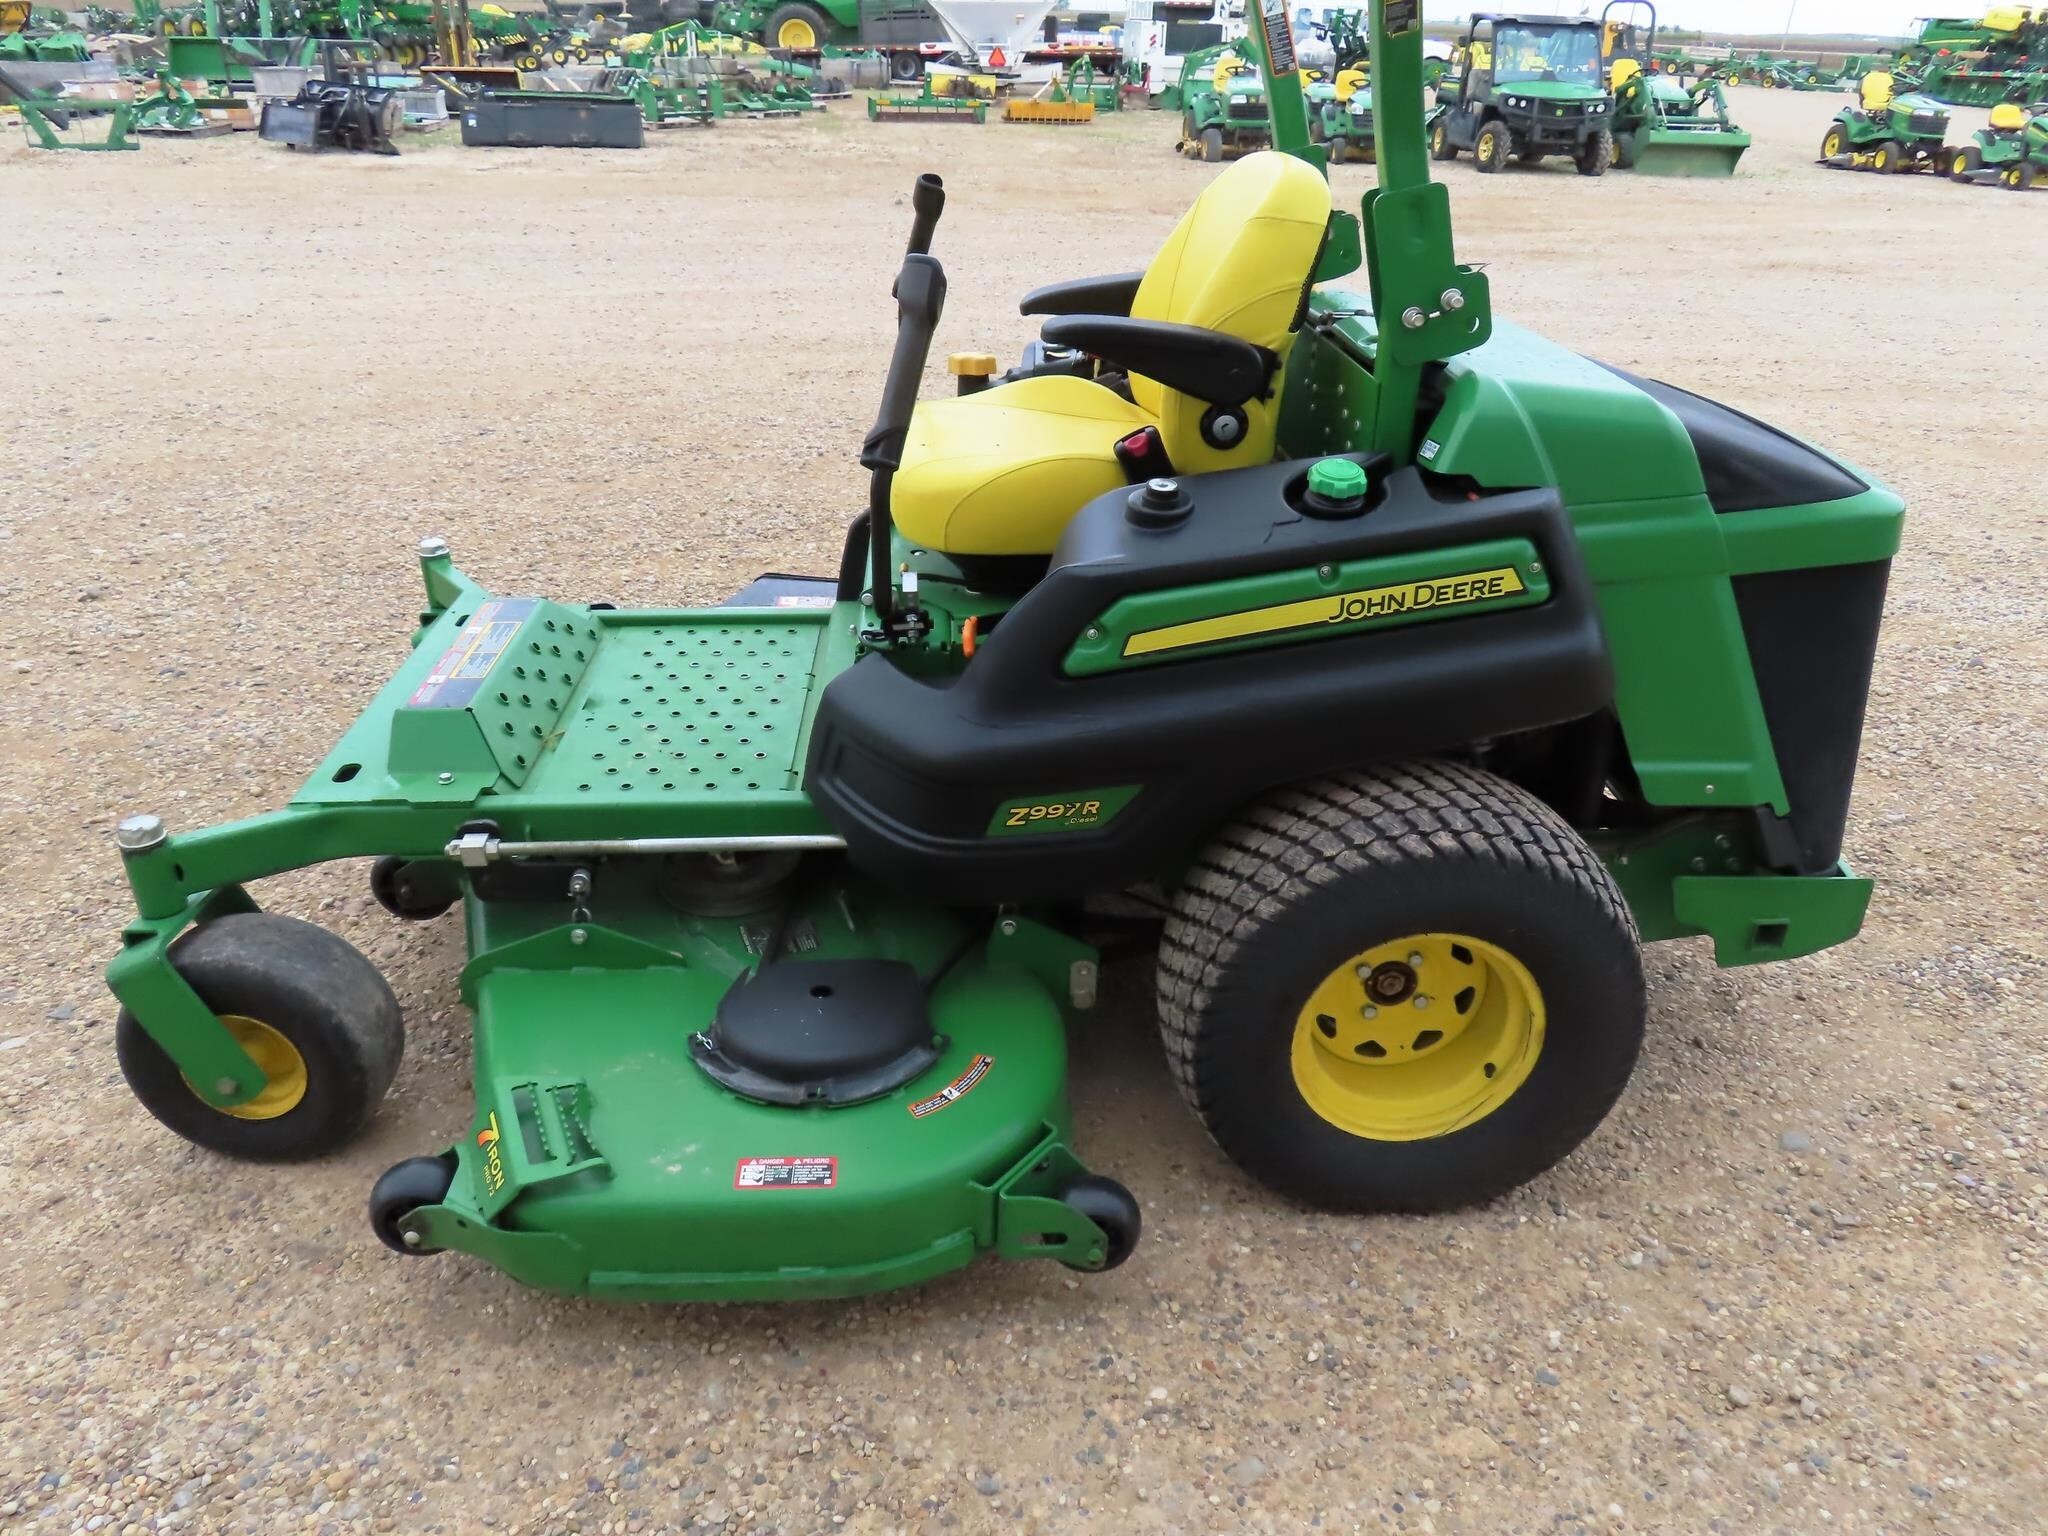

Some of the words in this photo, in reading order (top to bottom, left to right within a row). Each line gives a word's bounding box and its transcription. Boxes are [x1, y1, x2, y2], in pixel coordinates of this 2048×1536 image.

[1329, 591, 1406, 621] JOHN
[1413, 577, 1505, 607] DEERE
[1006, 801, 1100, 826] Z997R
